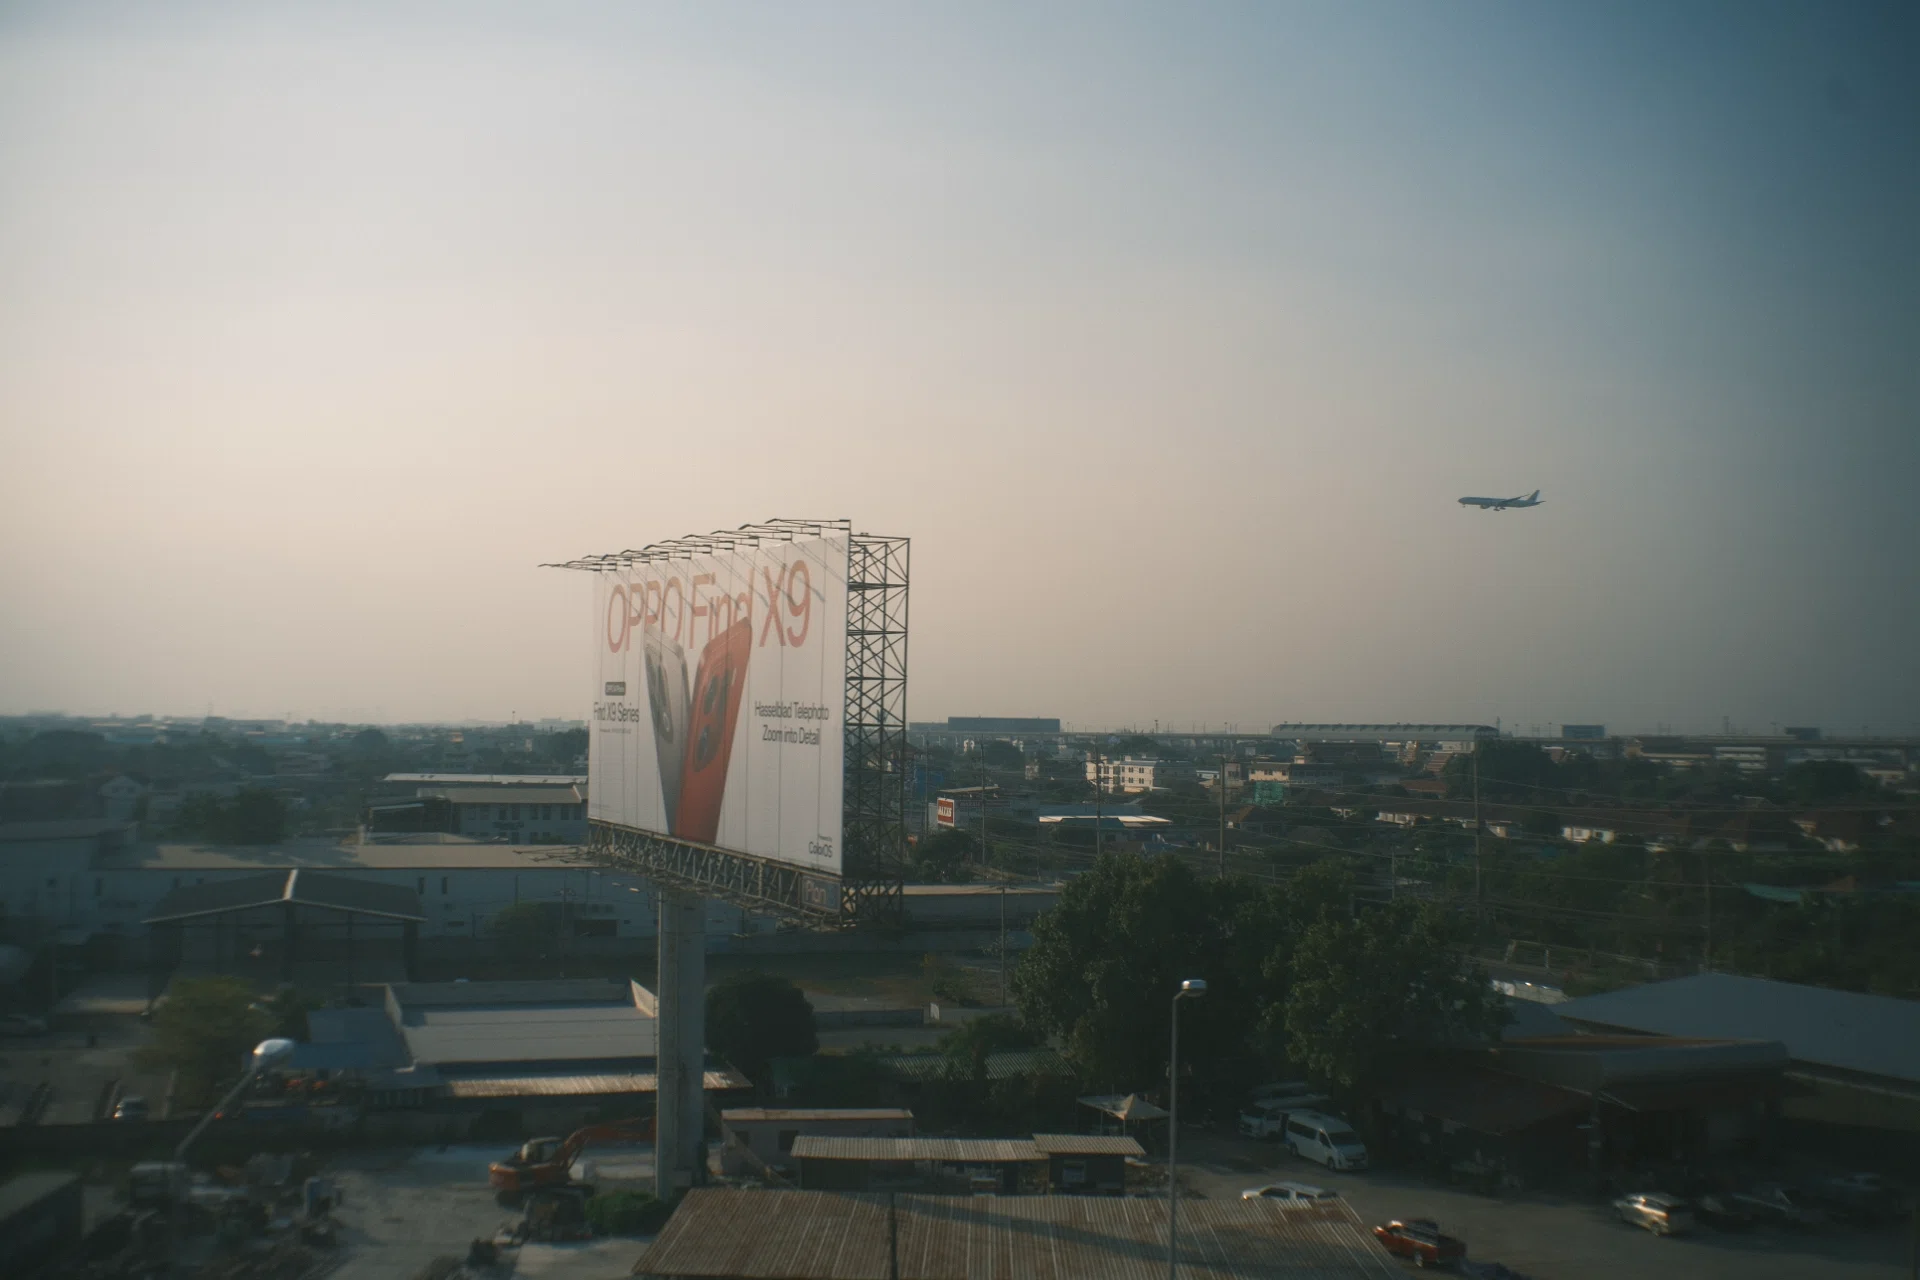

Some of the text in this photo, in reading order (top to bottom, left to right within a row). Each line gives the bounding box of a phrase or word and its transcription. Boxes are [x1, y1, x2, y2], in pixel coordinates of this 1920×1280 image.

[607, 559, 812, 653] OPPO Find X9
[593, 701, 640, 723] Find X9 Series
[754, 700, 829, 722] Hasselblad Telephoto
[762, 724, 820, 745] Zoom into Detail
[808, 841, 833, 858] ColorOS
